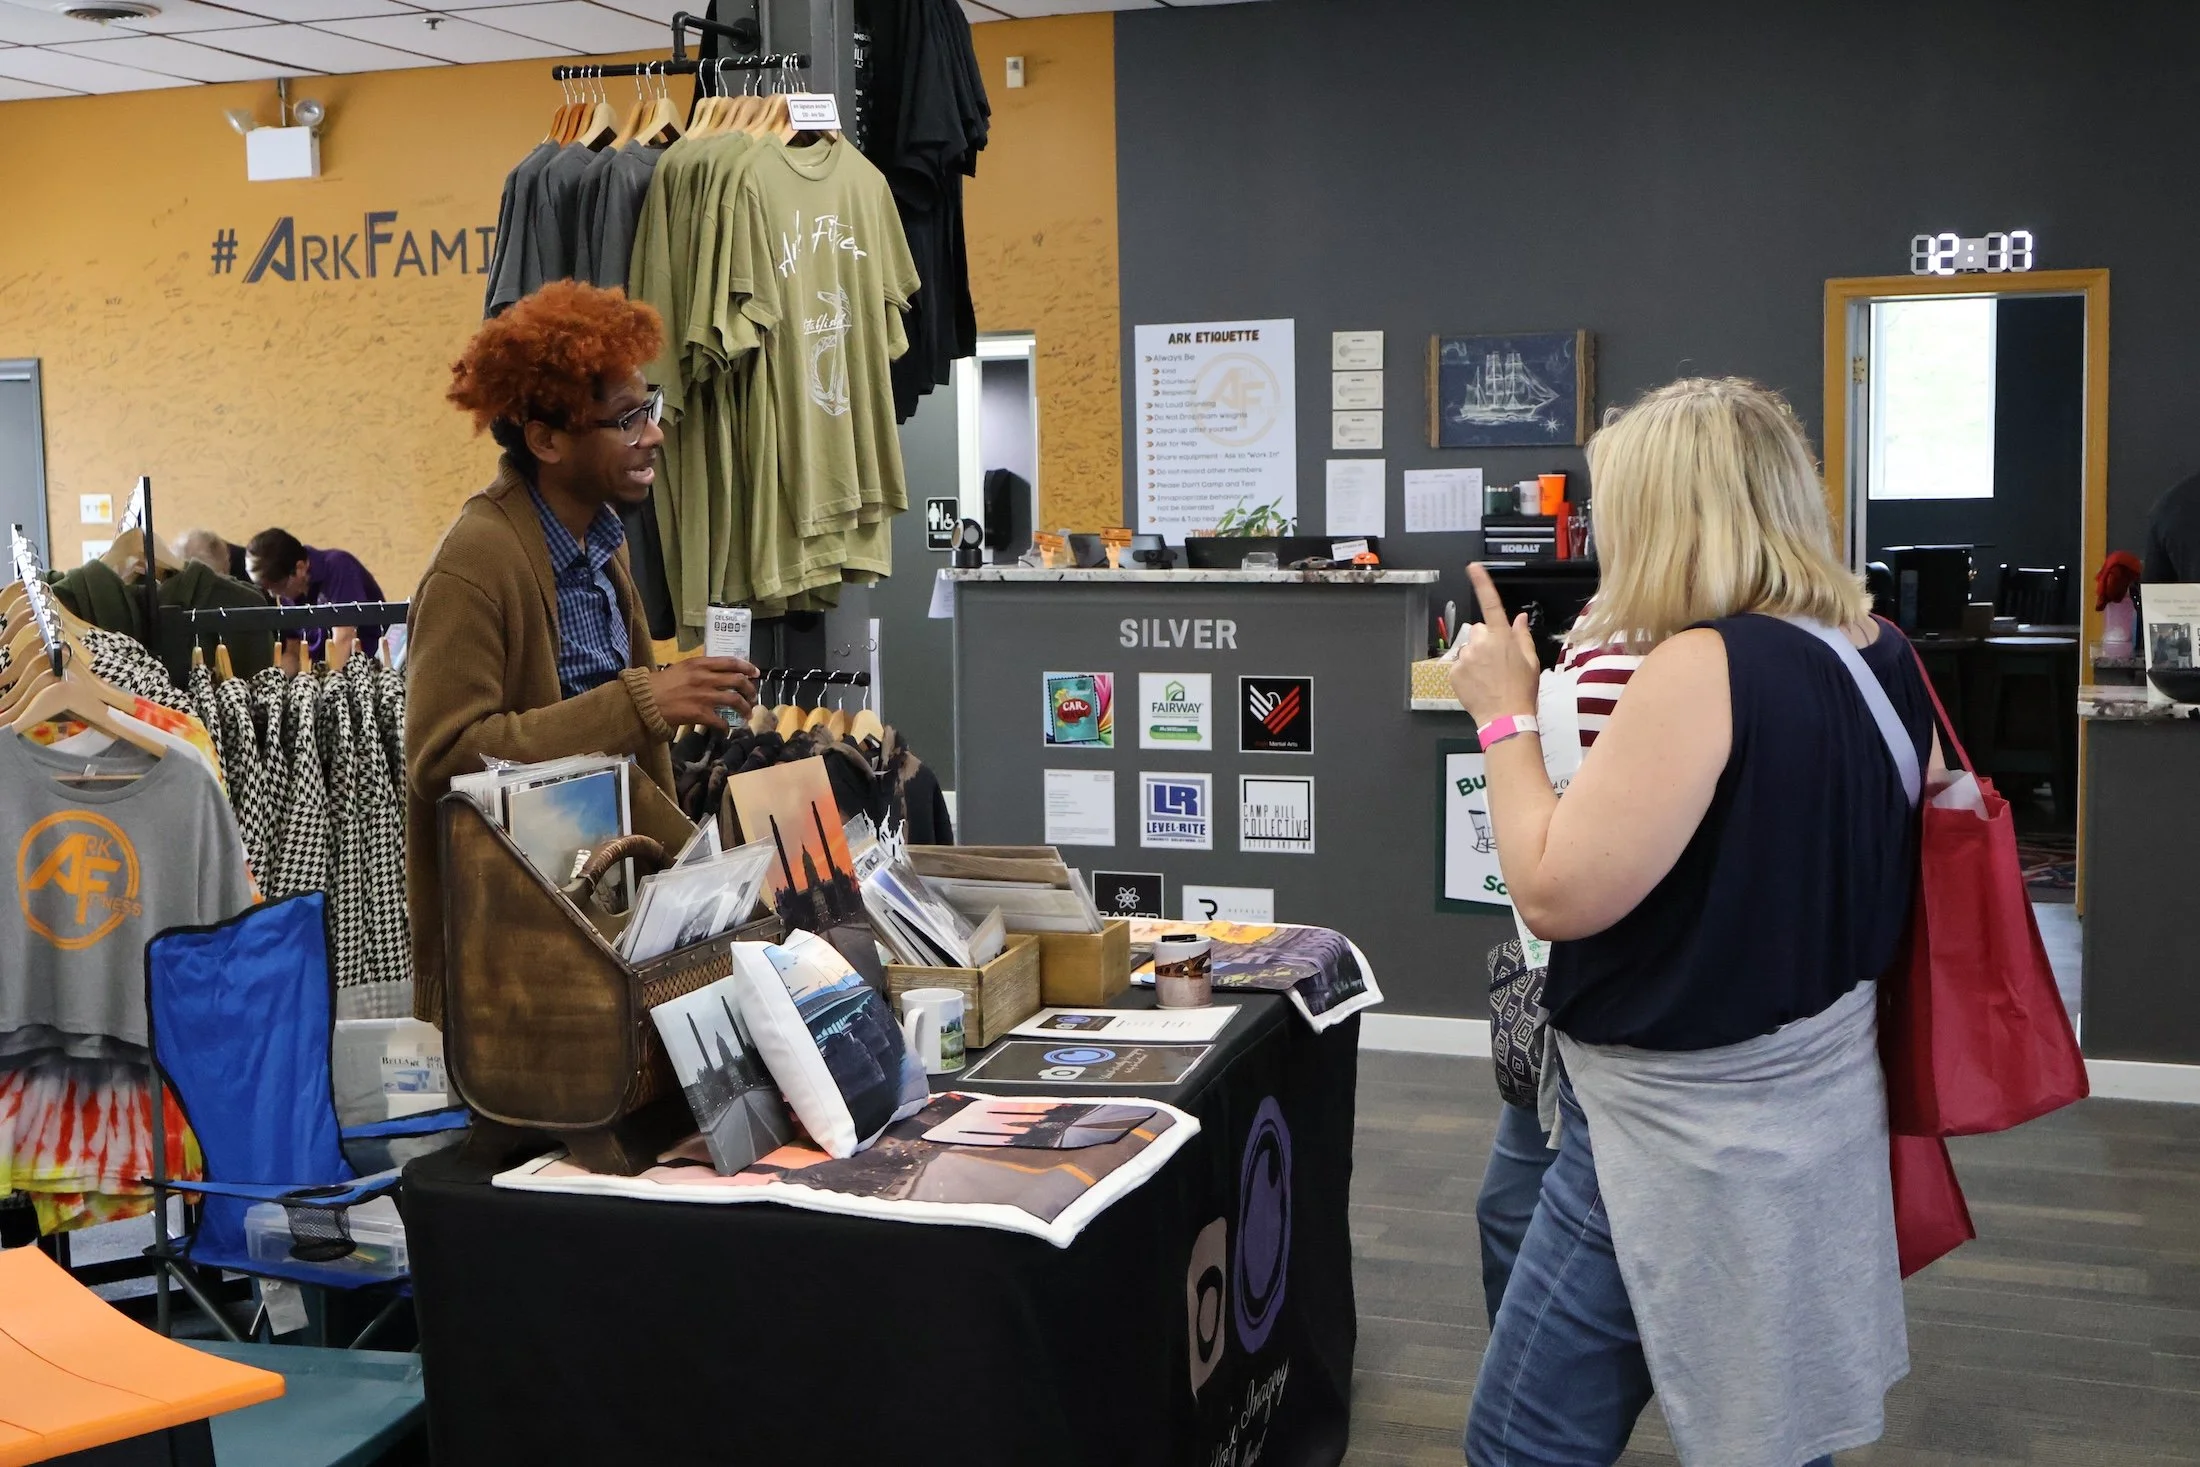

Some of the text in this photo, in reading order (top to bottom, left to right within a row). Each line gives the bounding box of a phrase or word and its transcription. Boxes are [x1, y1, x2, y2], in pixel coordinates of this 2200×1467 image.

[1927, 230, 2033, 276] 12:17
[1168, 329, 1260, 345] ARK ETIQUETTE
[1153, 353, 1196, 363] Always Be
[1178, 427, 1188, 435] up
[1181, 440, 1198, 448] Help
[1227, 466, 1263, 474] members
[1156, 481, 1180, 489] Please
[1225, 480, 1240, 488] and
[1501, 543, 1541, 553] KOBALT
[1120, 618, 1238, 650] SILVER
[1062, 700, 1089, 712] CAR
[1152, 701, 1201, 714] FAIRWAY
[1154, 784, 1198, 816] LR
[1243, 804, 1296, 819] CAMP HILL
[1243, 818, 1309, 839] COLLECTIVE
